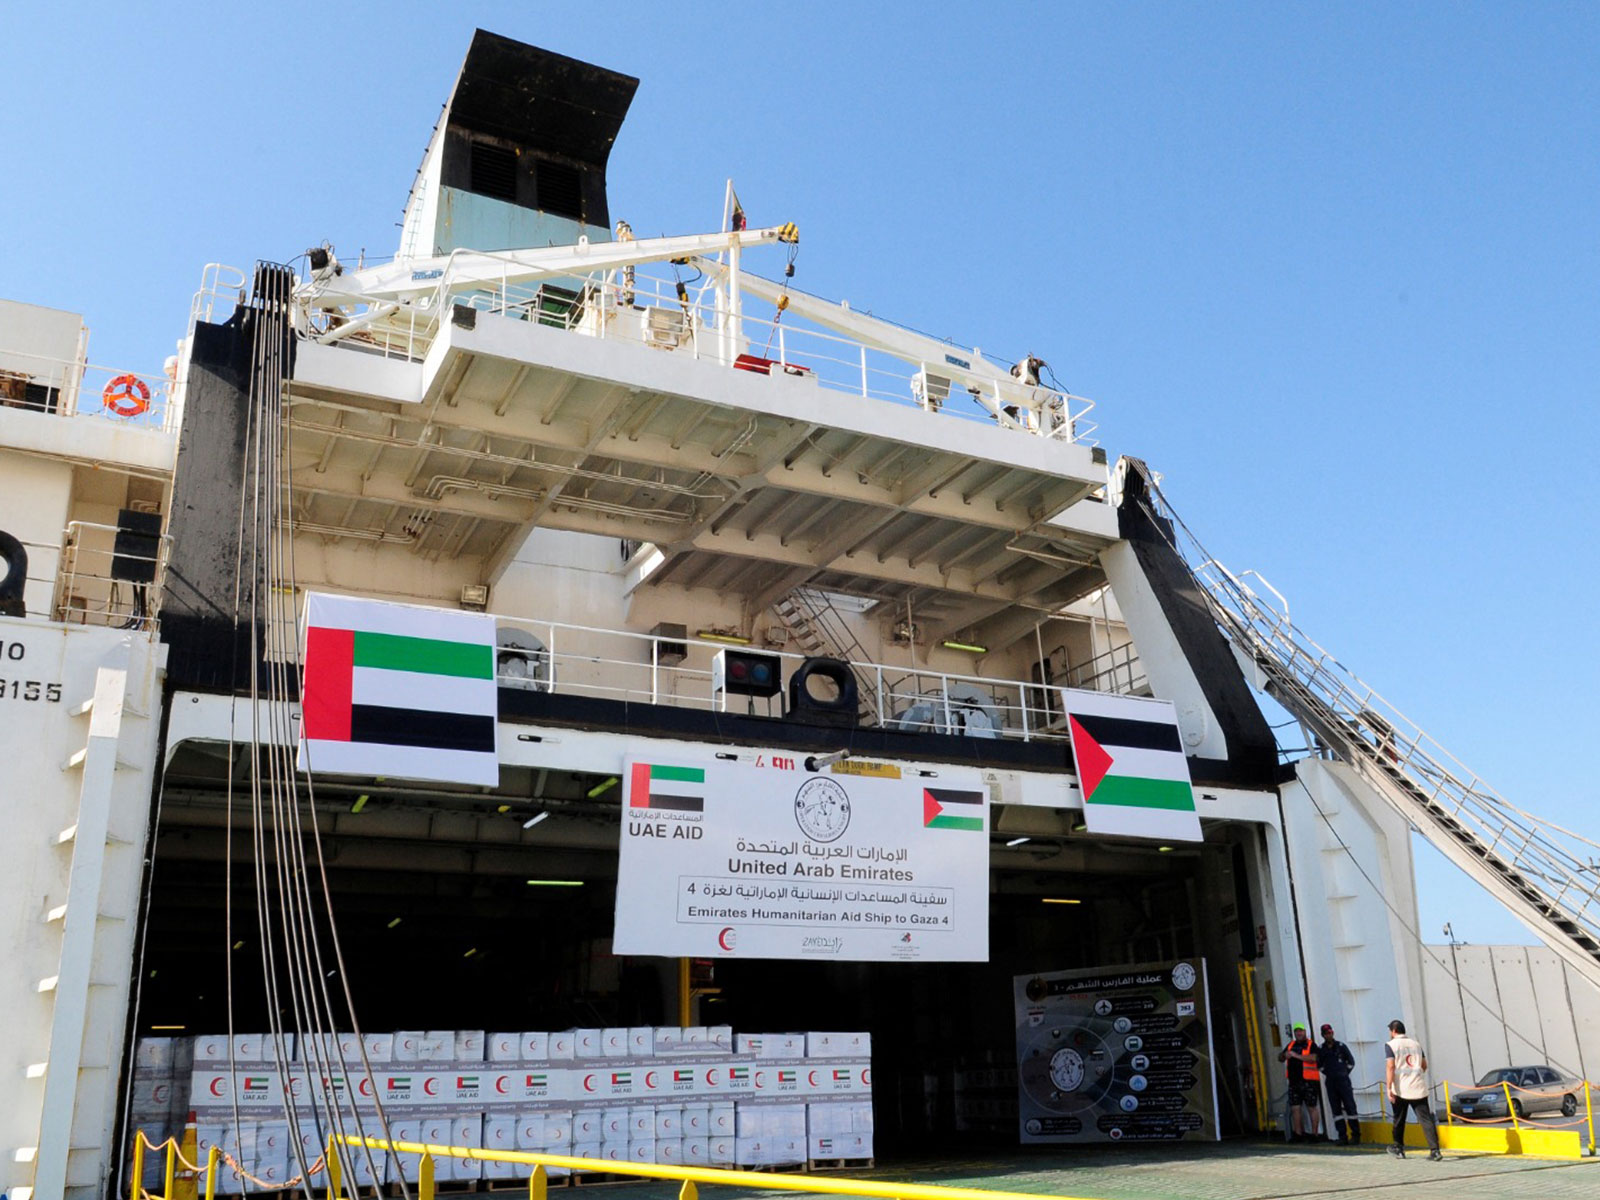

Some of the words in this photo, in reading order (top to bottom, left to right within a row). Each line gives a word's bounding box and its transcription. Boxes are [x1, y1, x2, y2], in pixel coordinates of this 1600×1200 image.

[628, 809, 661, 822] الإماراتية
[662, 812, 704, 823] المساعدات
[629, 822, 667, 838] UAE
[672, 825, 704, 840] AID
[736, 837, 798, 856] المتحدة
[802, 840, 853, 861] العربية
[857, 846, 908, 864] الإمارات
[728, 858, 787, 875] United
[793, 862, 835, 878] Arab
[840, 864, 914, 882] Emirates
[687, 882, 696, 895] 4
[703, 883, 733, 899] لغزة
[735, 883, 788, 901] الإماراتية
[791, 885, 843, 903] الإنسانية
[845, 890, 908, 904] المساعدات
[909, 891, 948, 908] سفينة
[688, 906, 747, 919] Emirates
[751, 908, 838, 921] Humanitarian
[840, 911, 862, 922] Aid
[865, 912, 892, 926] Ship
[895, 914, 907, 924] to
[910, 914, 939, 926] Gaza
[941, 915, 949, 926] 4
